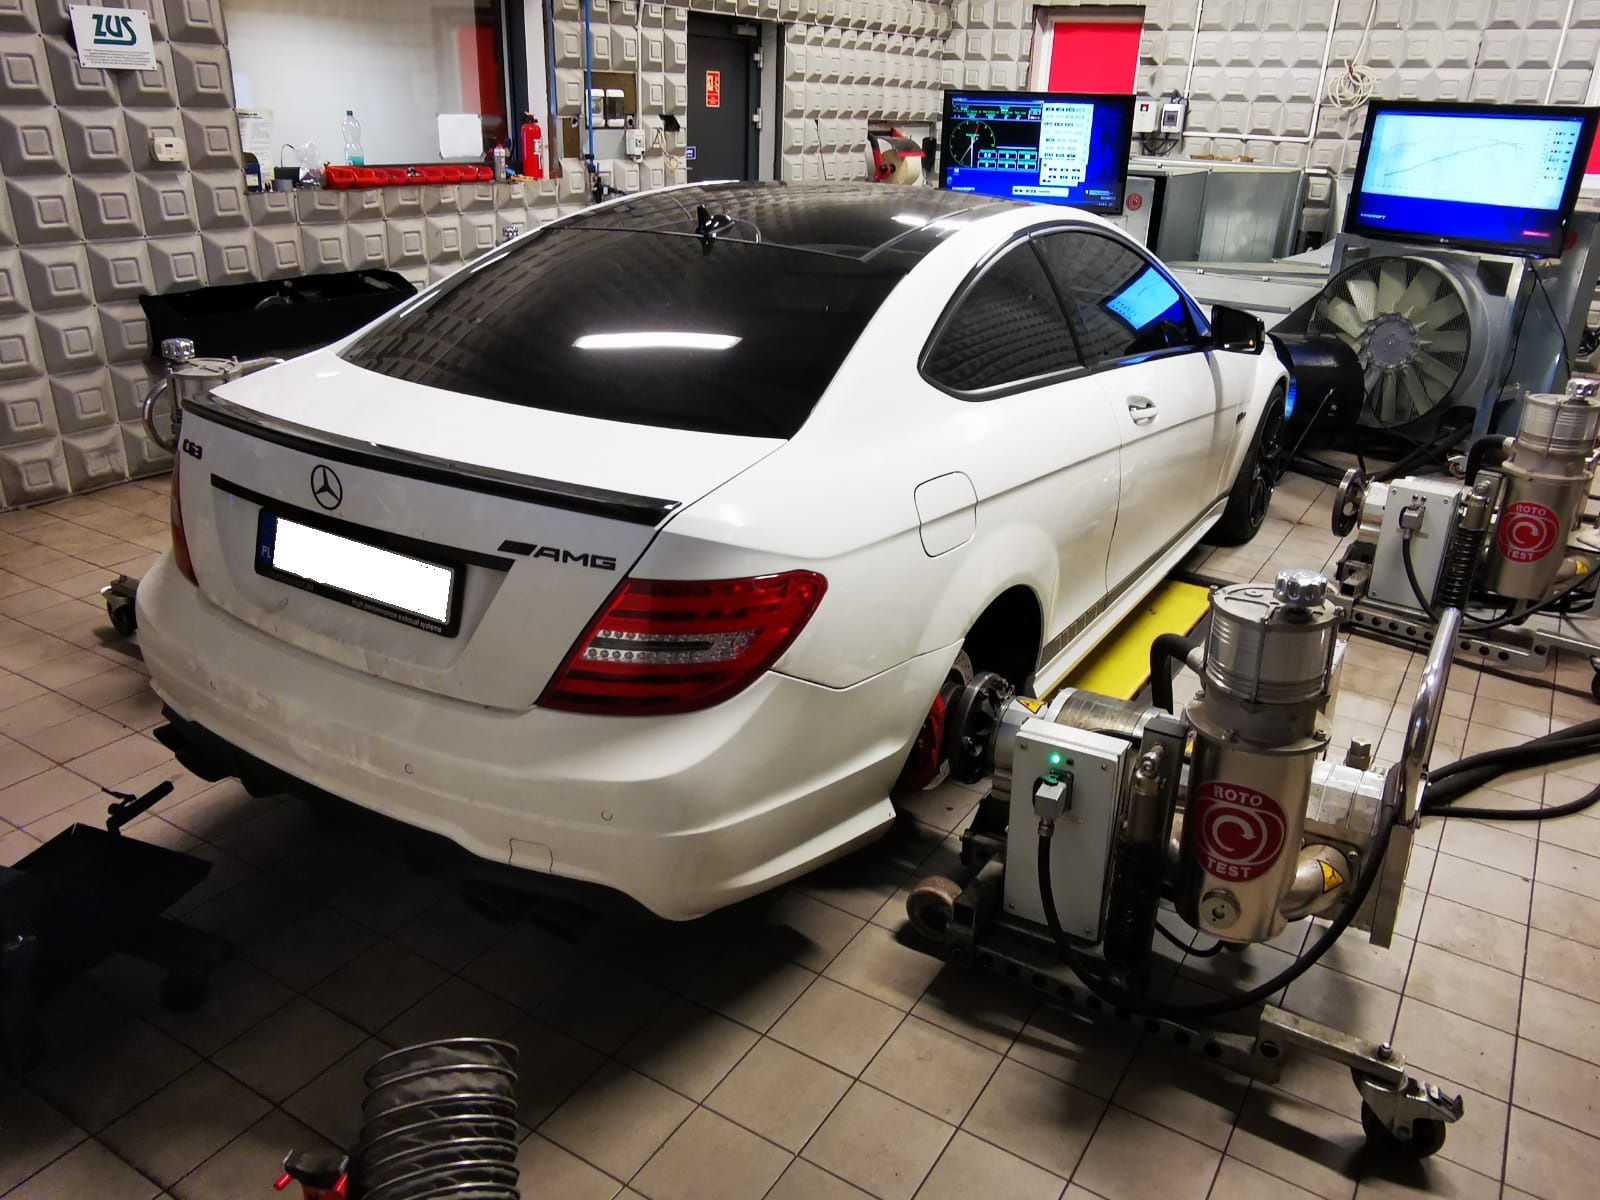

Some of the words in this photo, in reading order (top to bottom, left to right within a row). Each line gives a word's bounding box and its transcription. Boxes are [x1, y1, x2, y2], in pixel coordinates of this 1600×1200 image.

[92, 13, 137, 46] ZUS
[183, 439, 202, 460] C63
[1516, 504, 1547, 516] ROTO
[262, 545, 272, 559] PL
[533, 546, 617, 571] AMG
[1507, 548, 1534, 561] TEST
[420, 620, 442, 633] systems
[1213, 785, 1263, 807] ROTO
[1206, 857, 1252, 880] TEST
